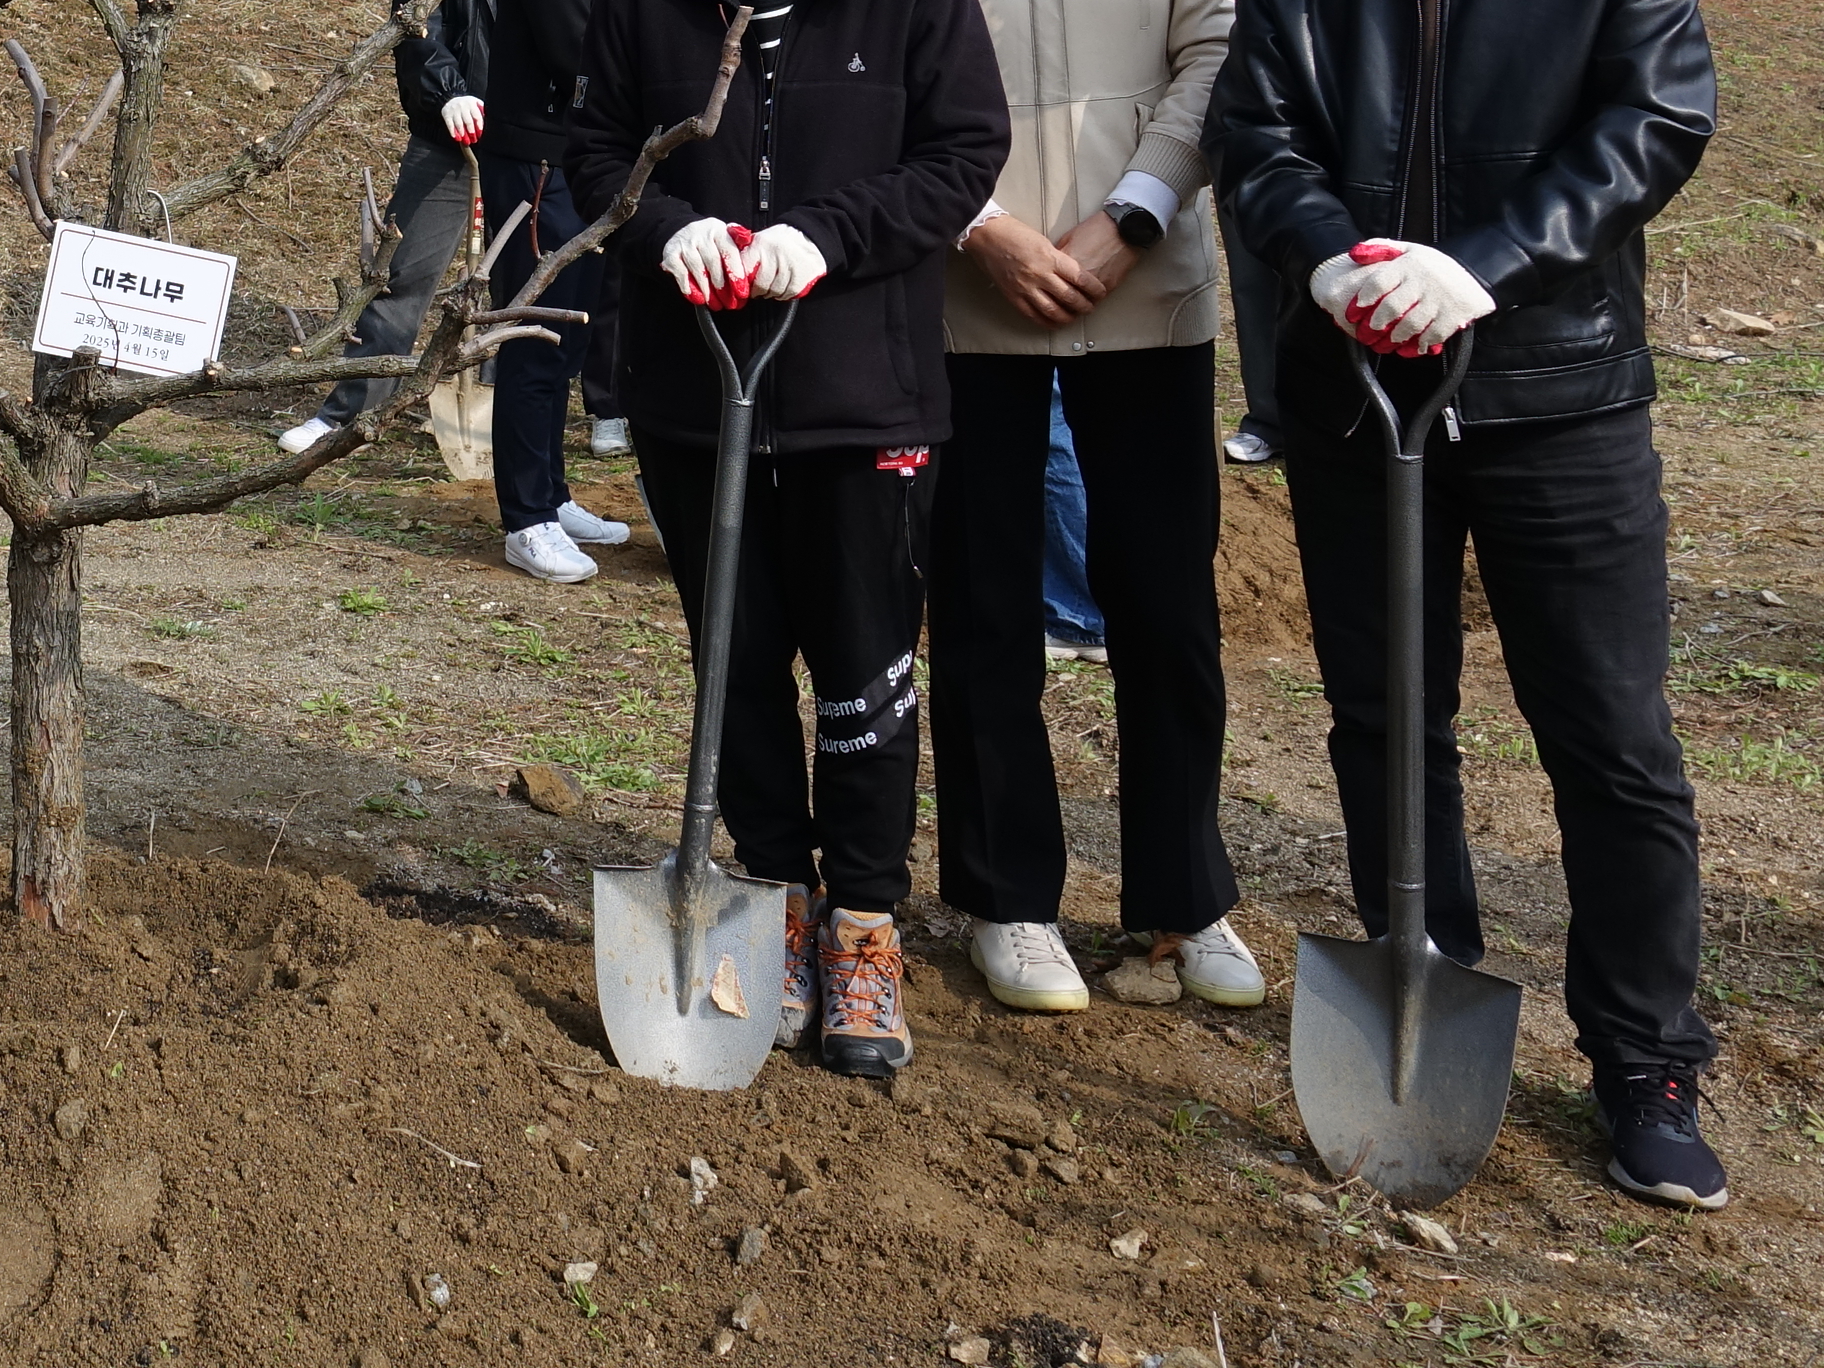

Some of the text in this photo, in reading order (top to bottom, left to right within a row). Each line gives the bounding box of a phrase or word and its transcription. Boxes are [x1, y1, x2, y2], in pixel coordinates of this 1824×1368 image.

[92, 266, 185, 303] 대추나무
[74, 312, 186, 346] 교육기획과 기획총괄팀
[82, 333, 170, 362] 2025년 4월 15일
